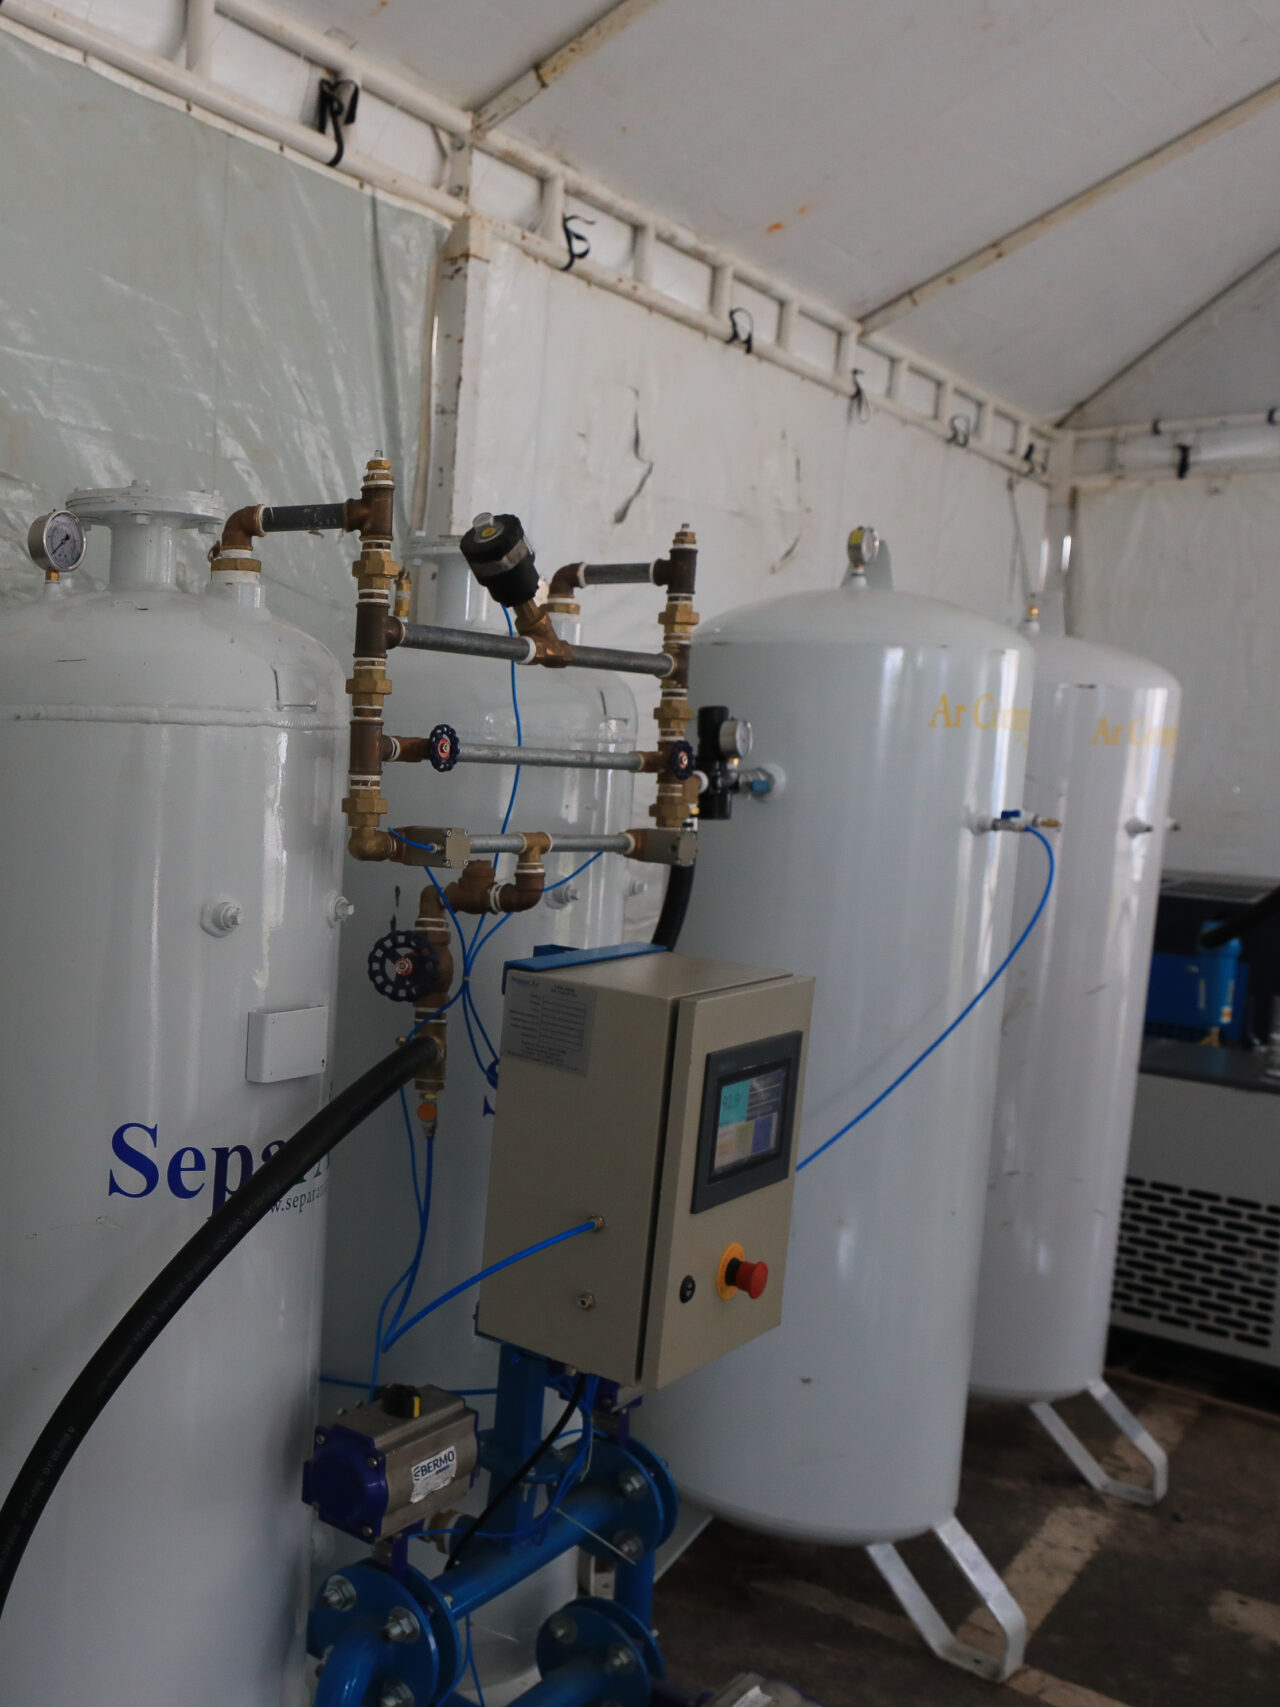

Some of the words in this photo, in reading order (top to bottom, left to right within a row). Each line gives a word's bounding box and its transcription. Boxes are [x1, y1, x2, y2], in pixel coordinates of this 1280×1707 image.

[928, 693, 967, 728] Ar
[1090, 716, 1124, 746] Ar
[420, 1450, 455, 1477] BERMO
